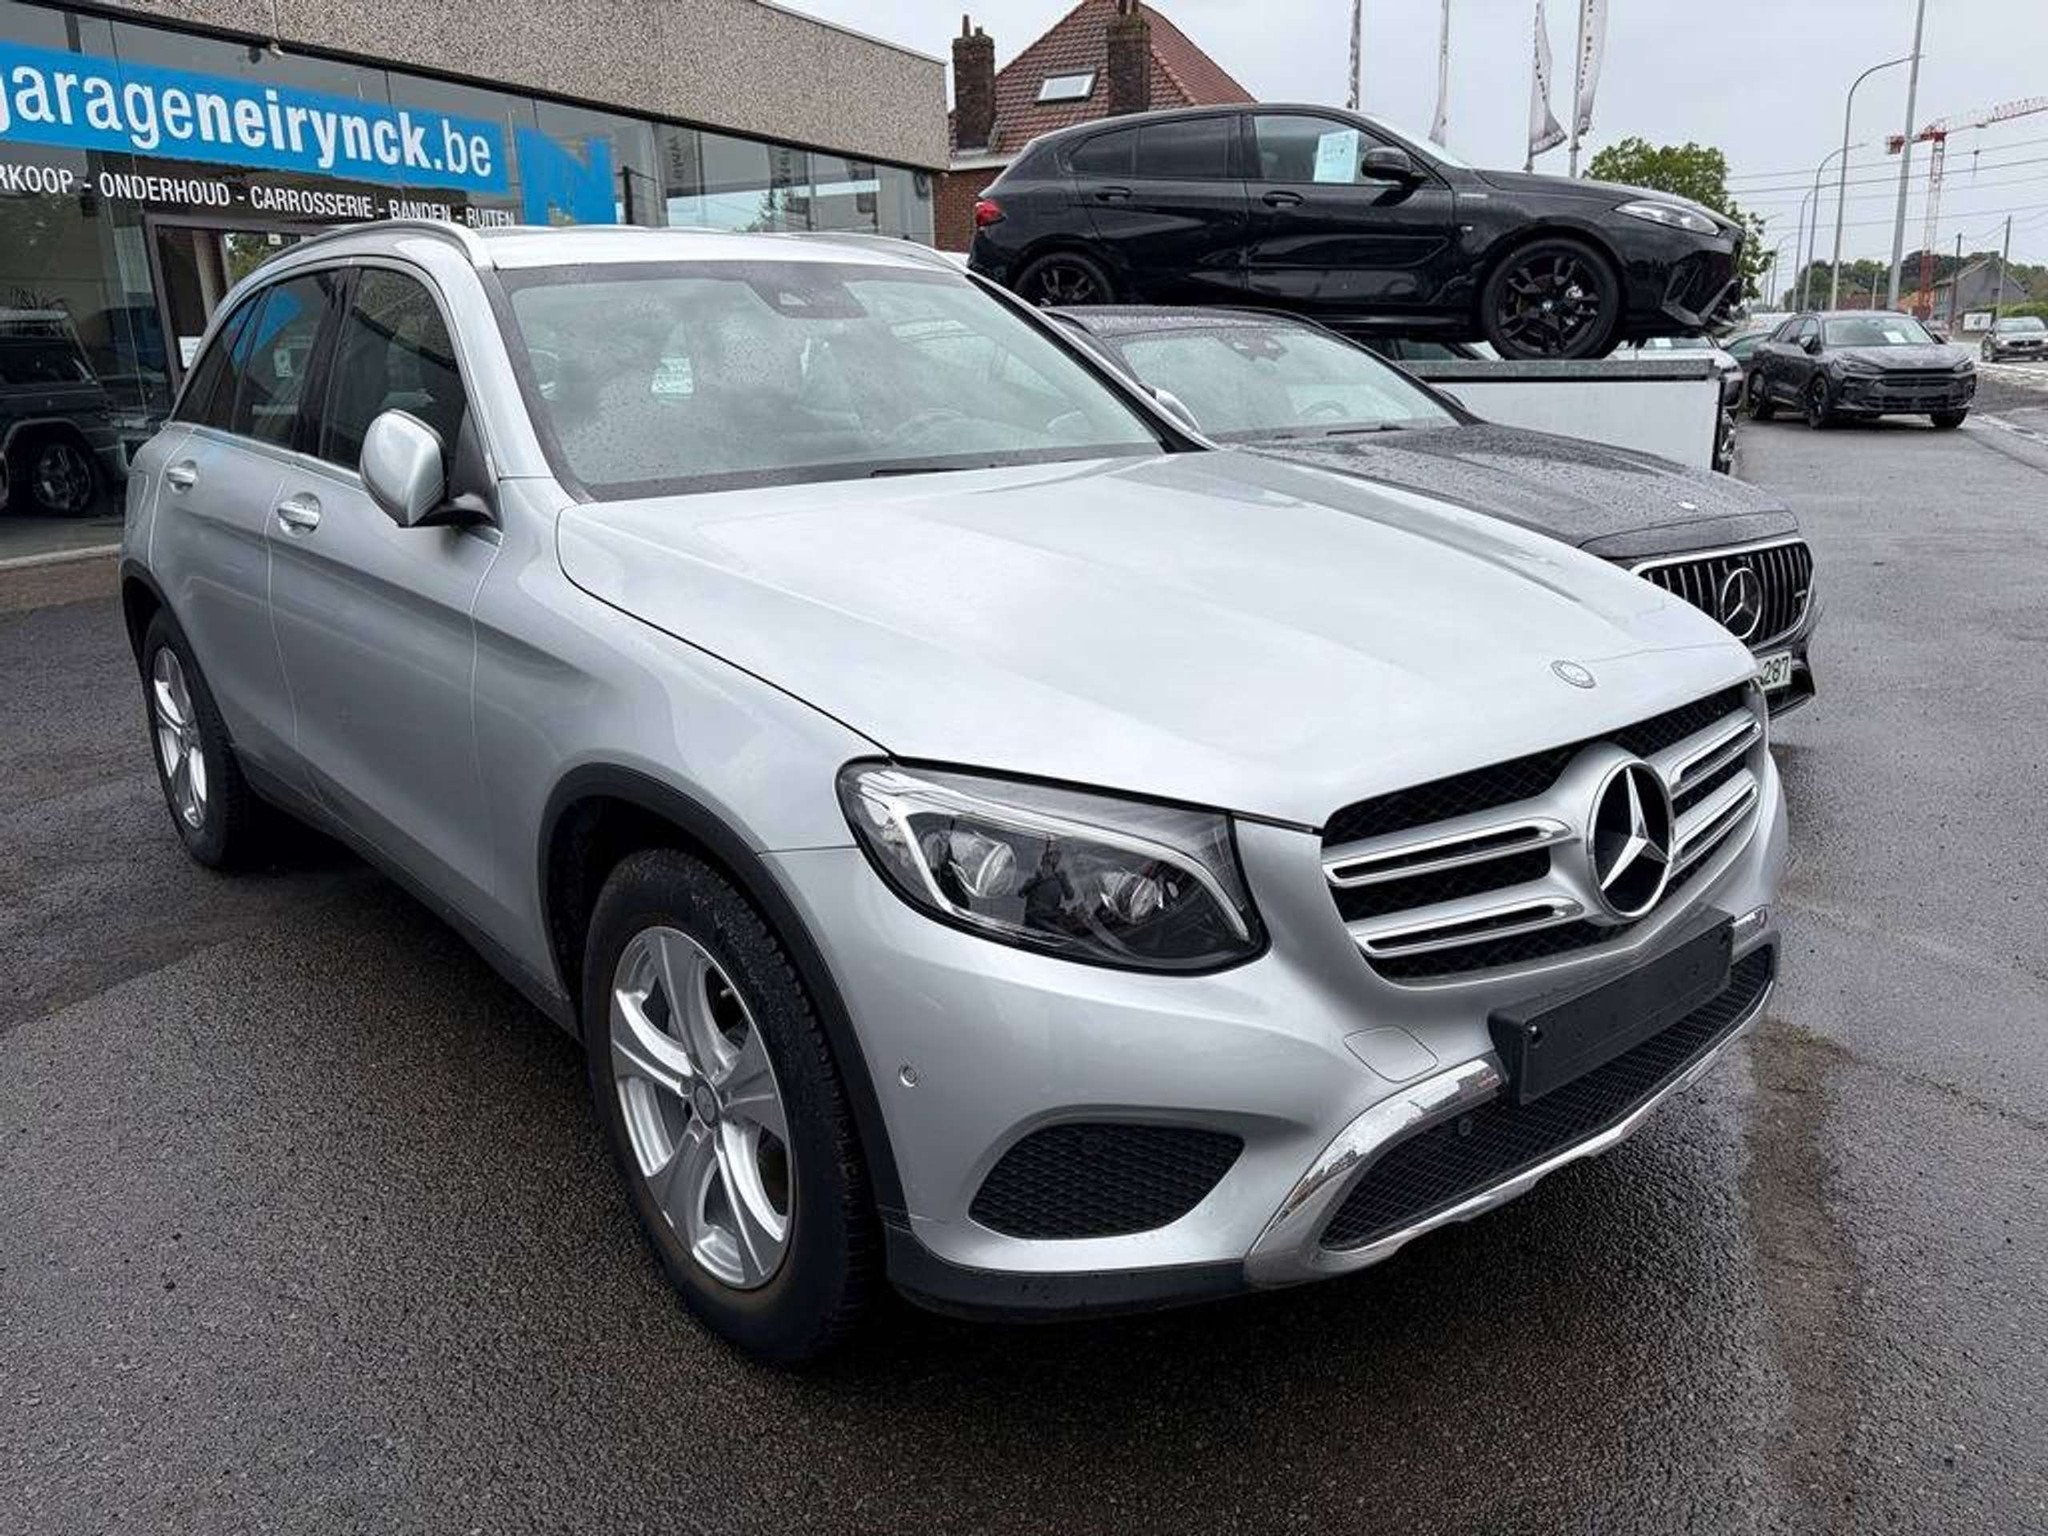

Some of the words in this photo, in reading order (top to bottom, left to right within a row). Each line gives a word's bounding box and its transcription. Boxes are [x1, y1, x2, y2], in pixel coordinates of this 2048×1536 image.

[100, 172, 230, 206] ONDERHOUD
[250, 185, 374, 218] CARROSSERIE
[389, 199, 451, 222] BANDEN
[466, 207, 514, 229] RUITEN
[1760, 656, 1789, 685] 287
